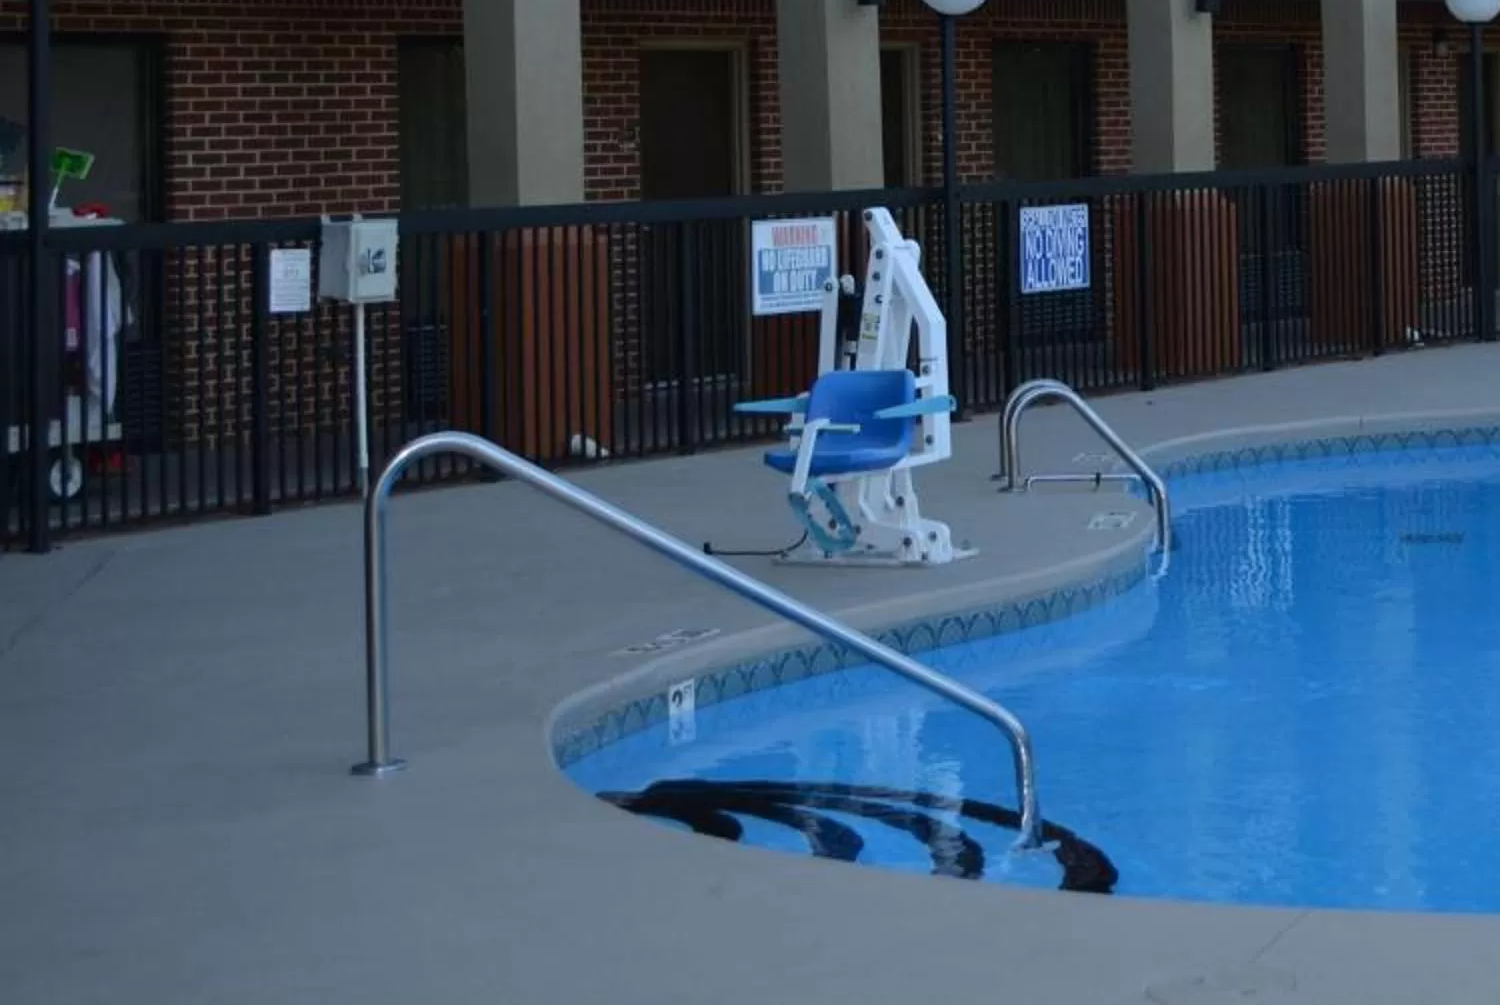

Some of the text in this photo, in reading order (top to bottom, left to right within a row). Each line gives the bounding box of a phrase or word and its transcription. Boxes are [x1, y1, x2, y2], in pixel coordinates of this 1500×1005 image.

[1025, 226, 1085, 259] NO DIVING
[1025, 257, 1083, 288] ALLOWED
